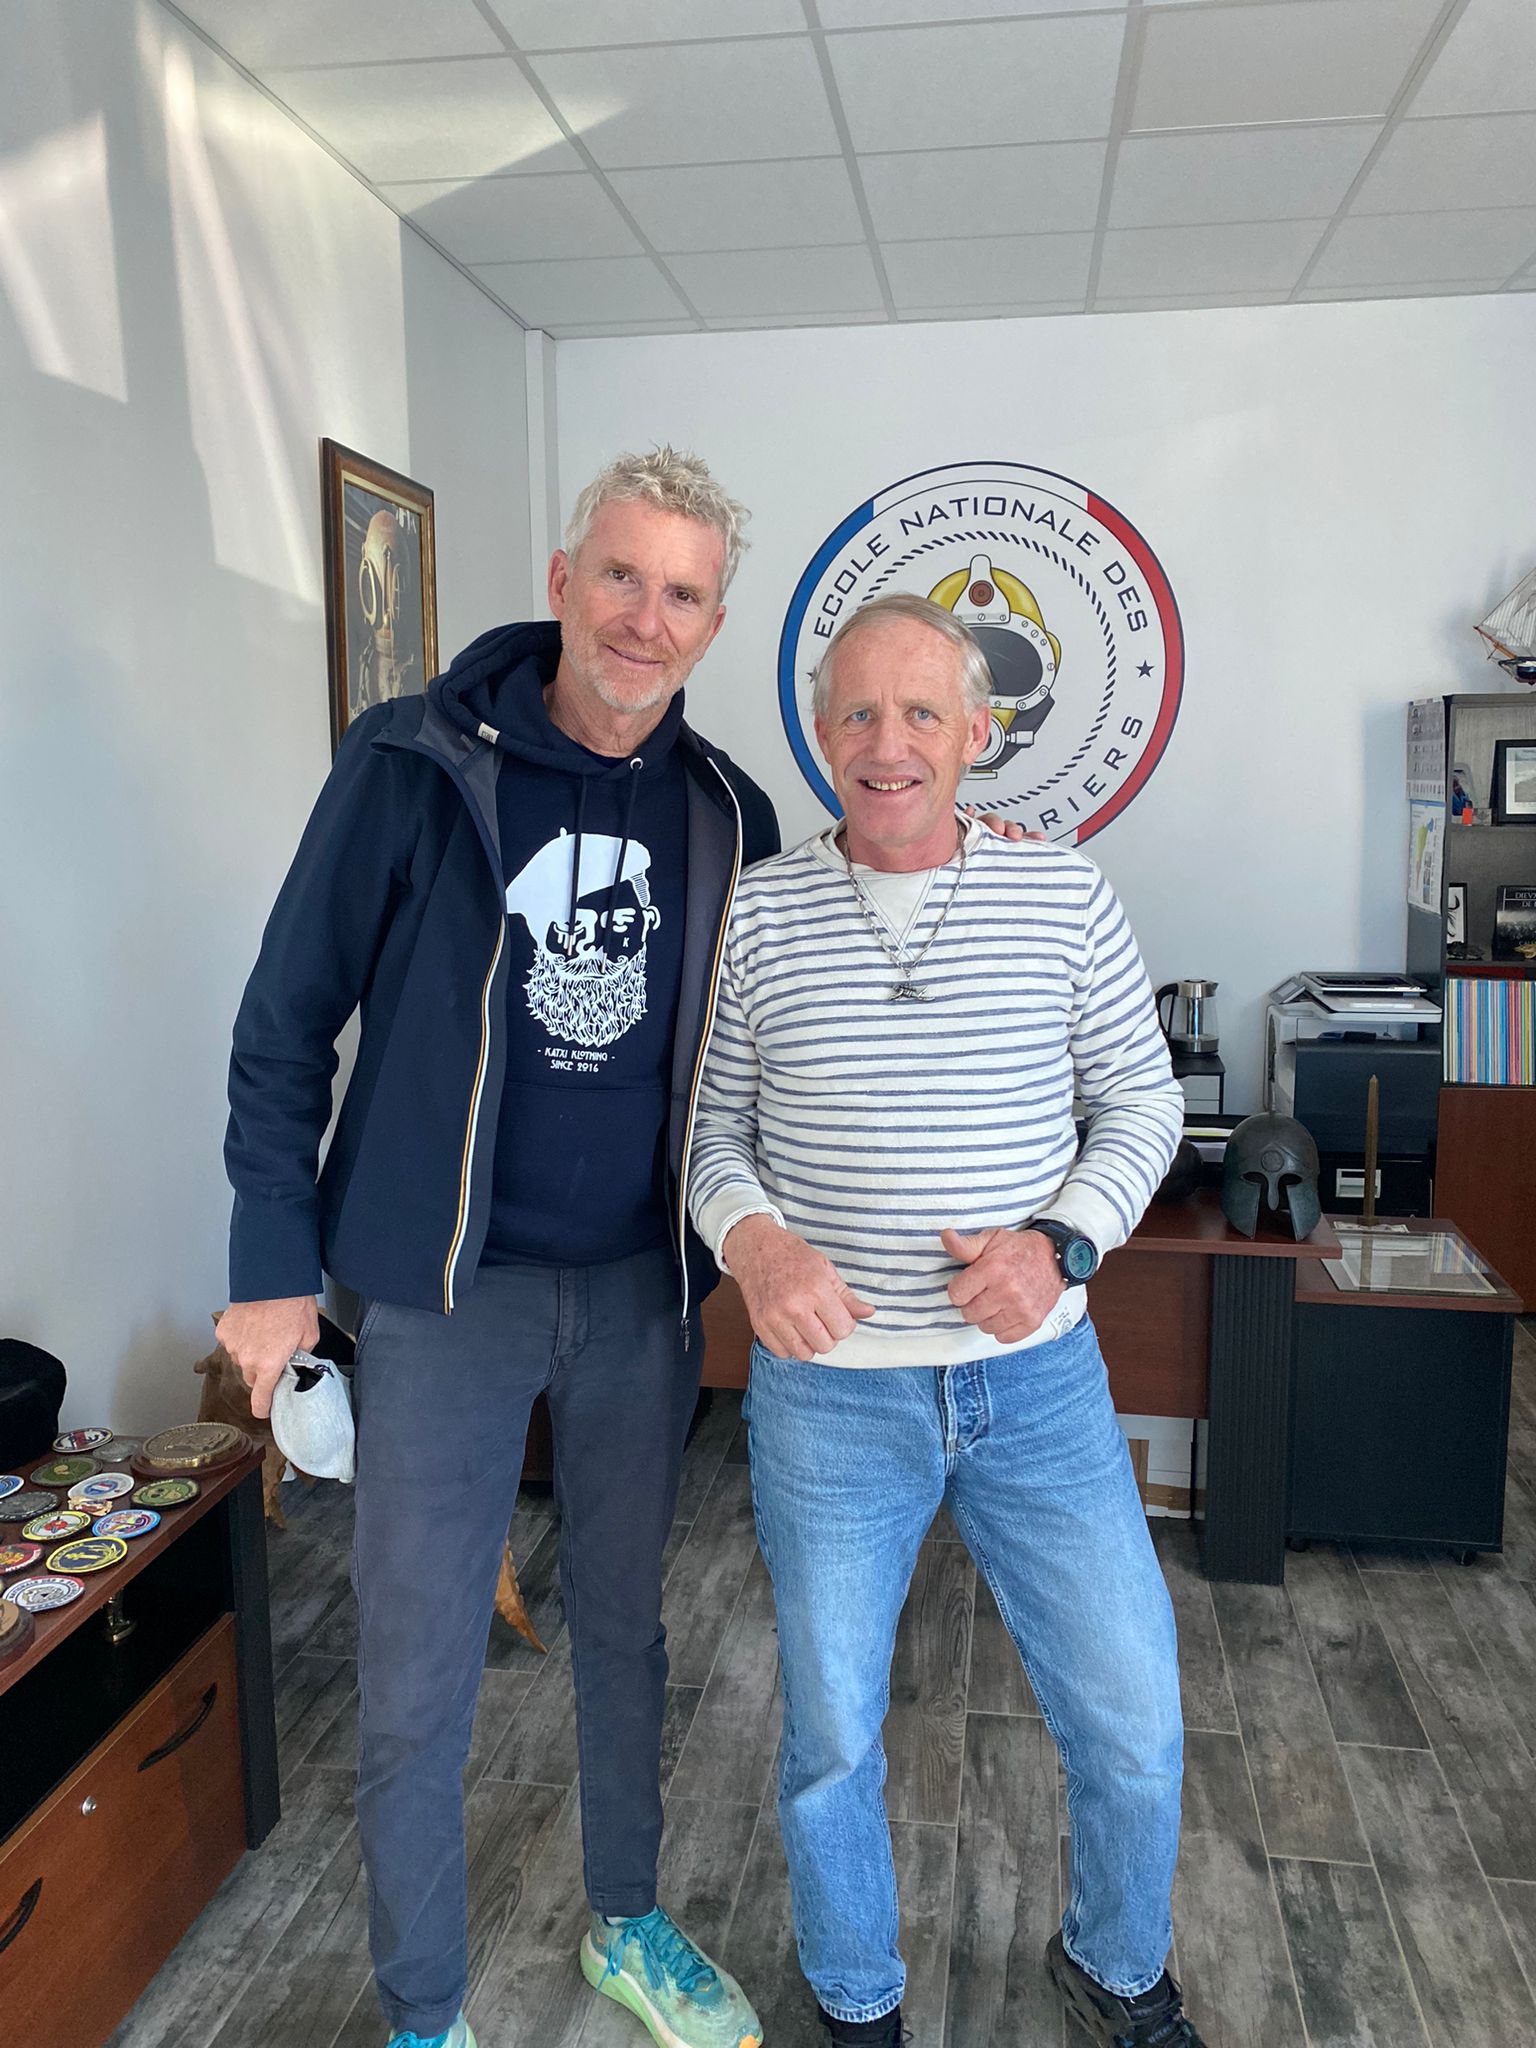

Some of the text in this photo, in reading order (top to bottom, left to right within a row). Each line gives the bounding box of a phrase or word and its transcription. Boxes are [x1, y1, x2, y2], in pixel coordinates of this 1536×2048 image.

[814, 496, 1150, 640] ECOLE NATIONALE DES
[1017, 715, 1144, 833] RIERS
[544, 1047, 608, 1062] KATXI KLOTHING
[550, 1059, 600, 1072] SINCE 2016
